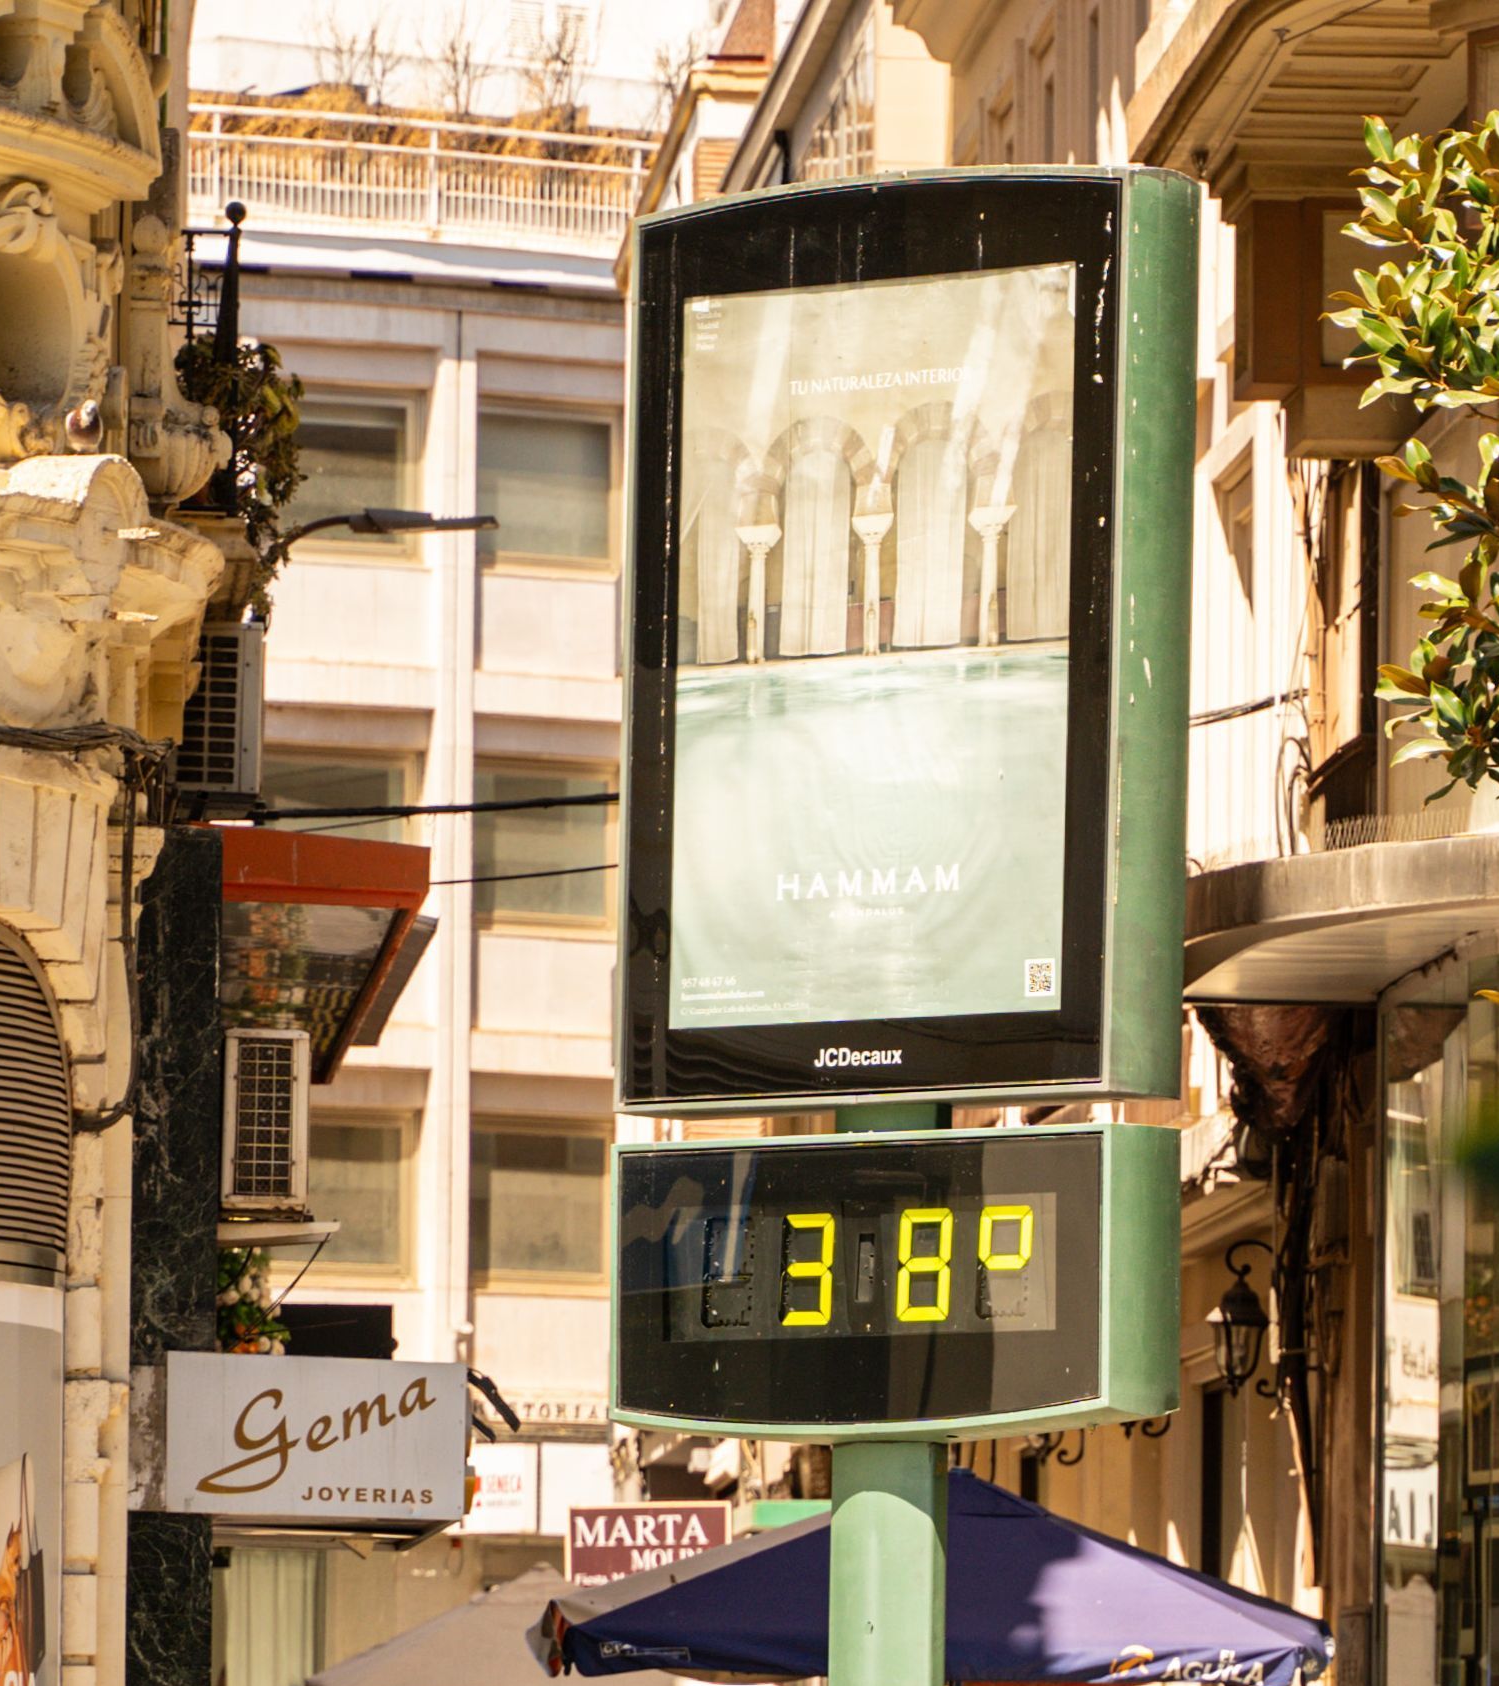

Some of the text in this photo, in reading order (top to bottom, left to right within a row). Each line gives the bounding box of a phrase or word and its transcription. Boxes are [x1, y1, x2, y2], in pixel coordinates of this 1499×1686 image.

[790, 380, 809, 395] TU
[811, 372, 901, 393] NATURALEZA
[776, 864, 960, 901] HAMMAM
[814, 1048, 903, 1067] JCDecaux
[195, 1377, 437, 1494] Gema
[302, 1487, 434, 1504] JOYERIAS
[575, 1514, 709, 1548] MARTA
